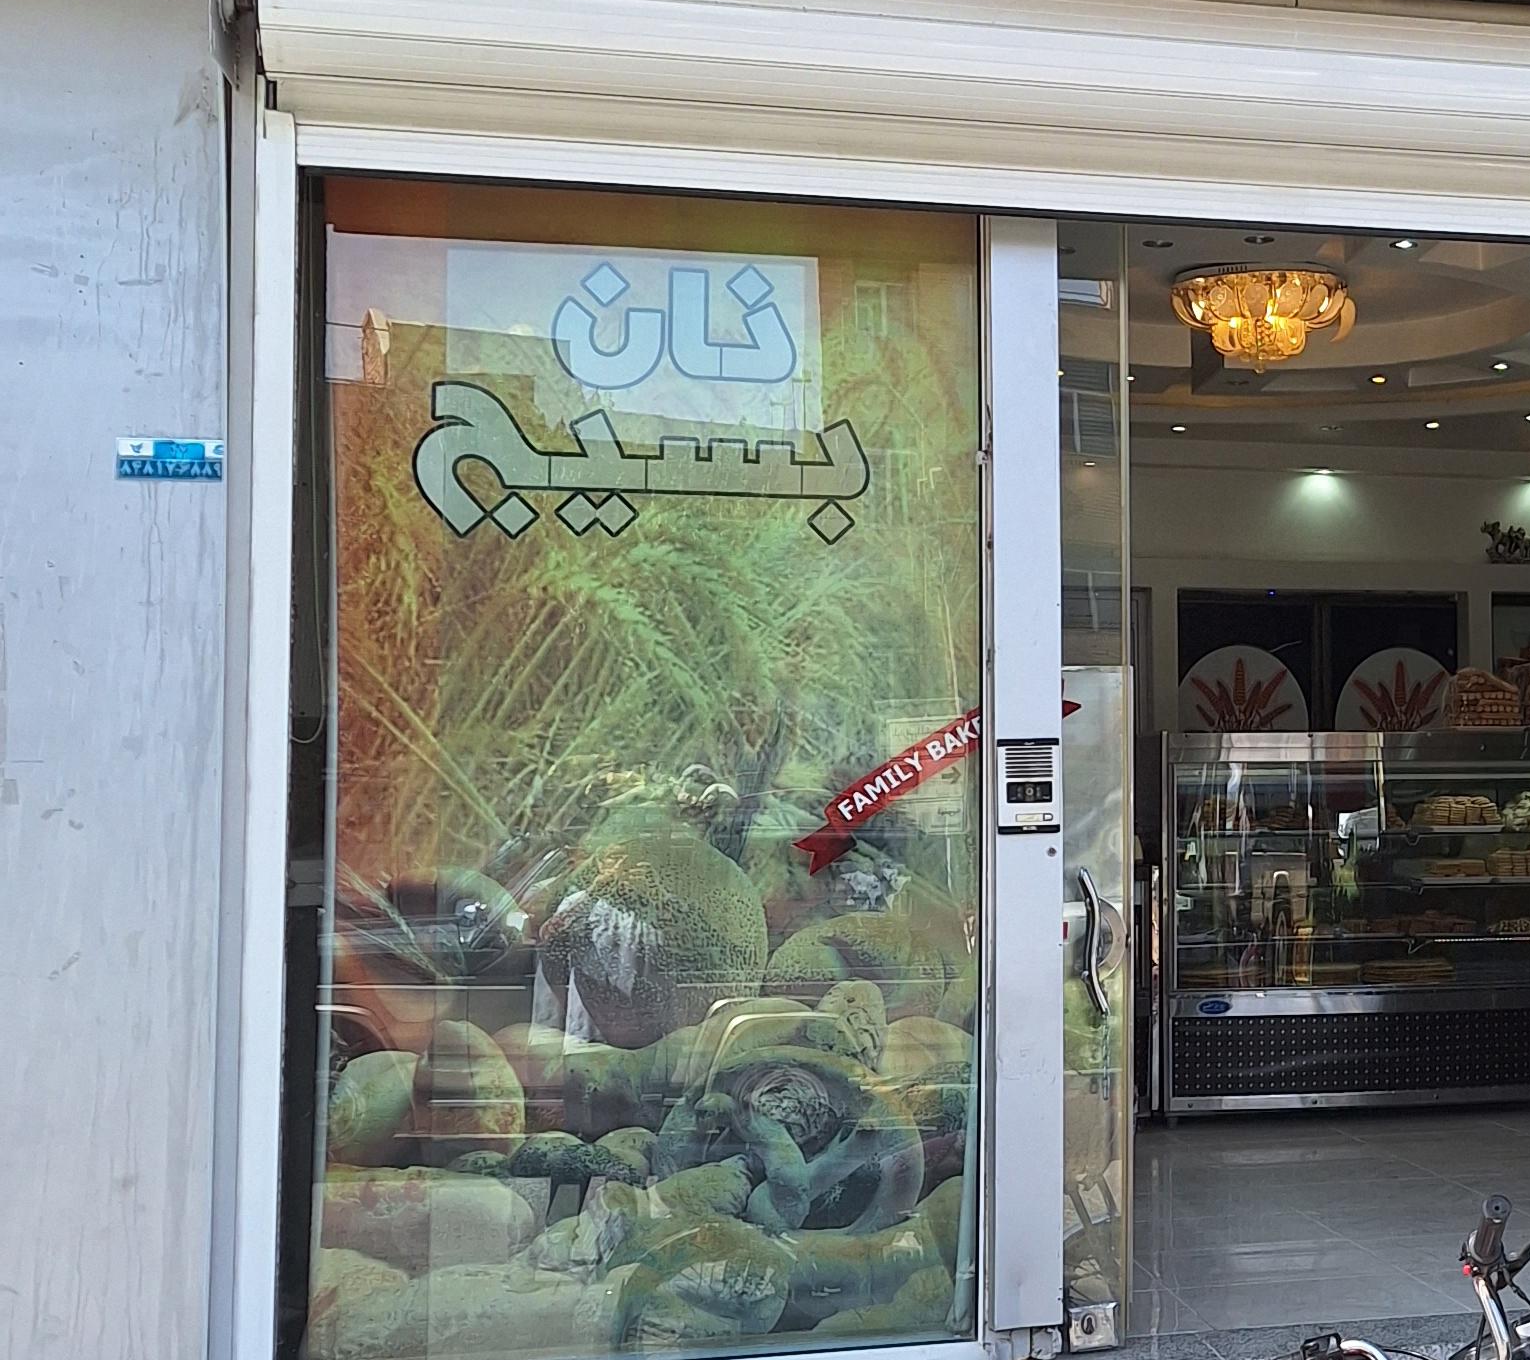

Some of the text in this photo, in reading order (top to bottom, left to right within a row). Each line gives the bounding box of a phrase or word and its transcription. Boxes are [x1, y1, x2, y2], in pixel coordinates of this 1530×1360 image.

[552, 262, 797, 390] نان
[412, 381, 870, 545] بسیج
[837, 751, 923, 822] FAMILY
